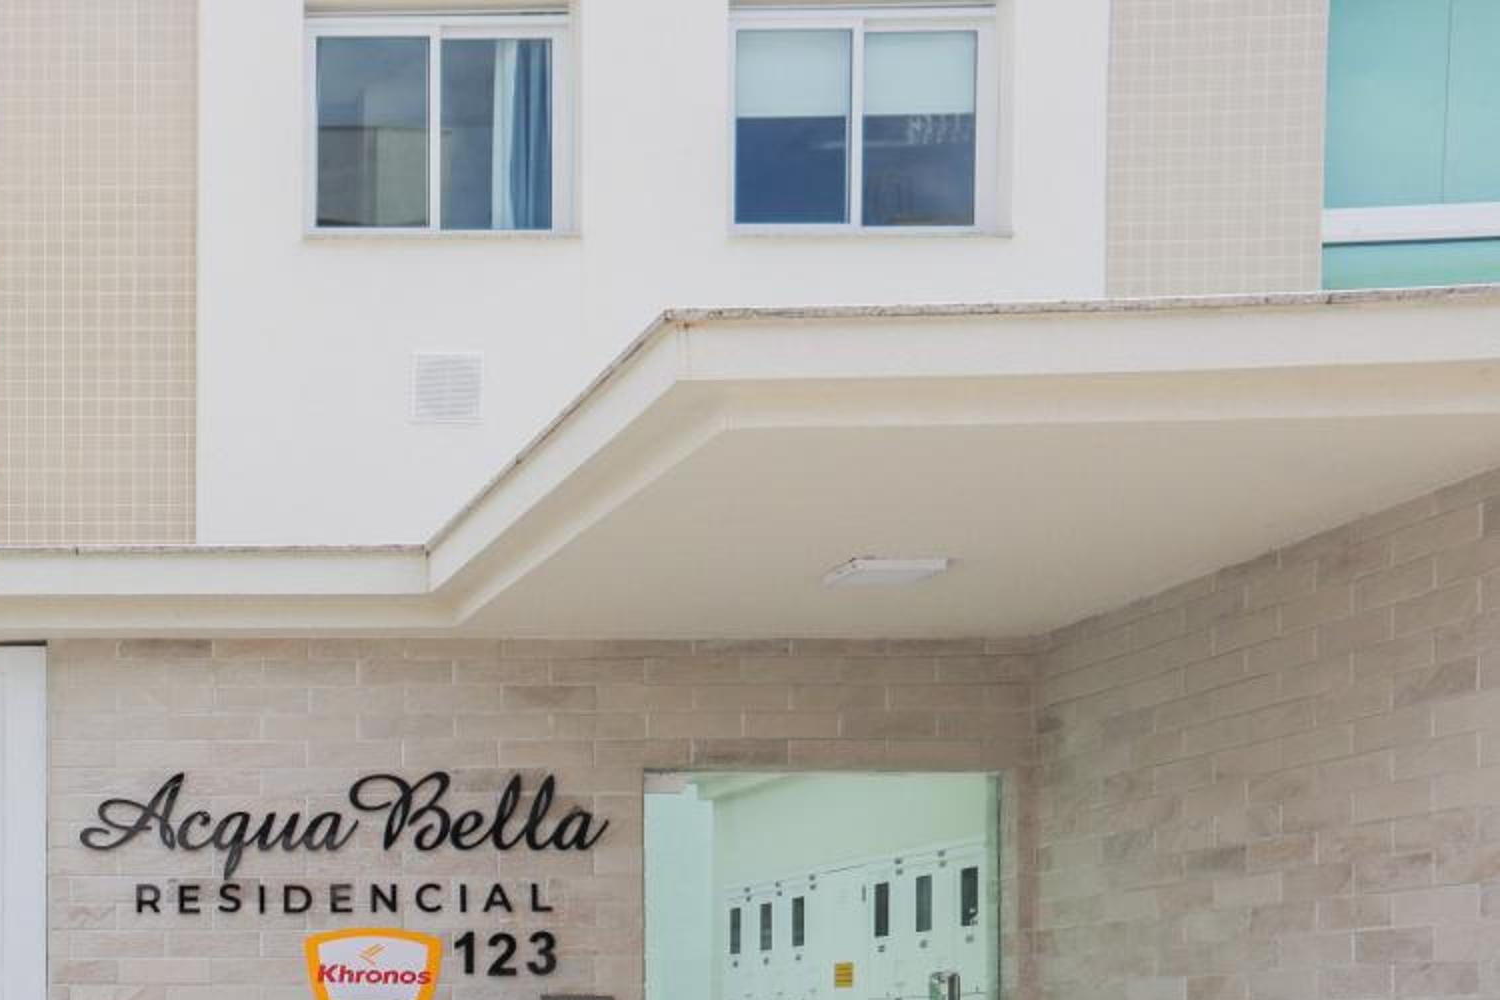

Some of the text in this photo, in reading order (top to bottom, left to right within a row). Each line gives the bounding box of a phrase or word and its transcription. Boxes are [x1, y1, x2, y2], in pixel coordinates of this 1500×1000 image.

[80, 771, 609, 880] Acqua Bella
[135, 883, 554, 914] RESIDENCIAL
[453, 931, 559, 977] 123
[317, 963, 432, 985] Khronos
